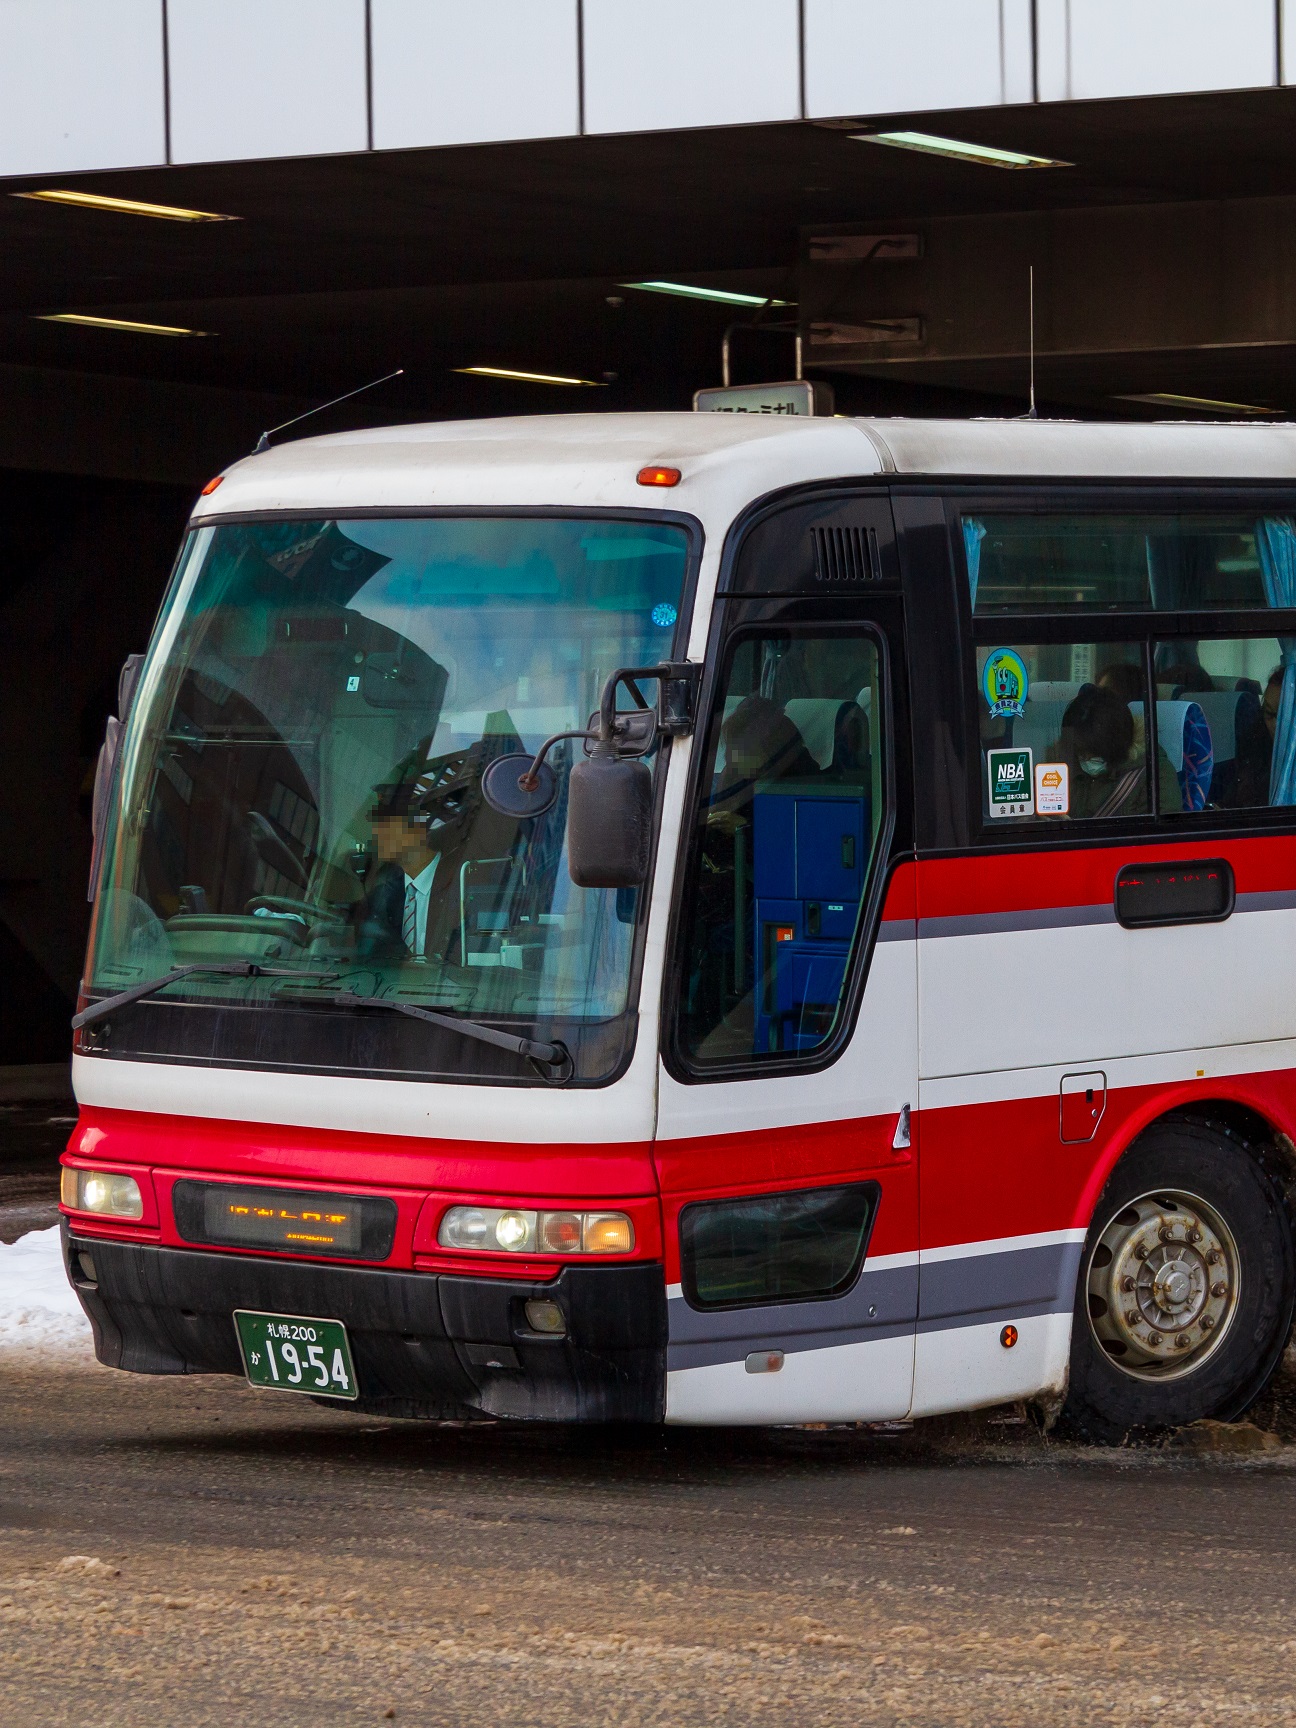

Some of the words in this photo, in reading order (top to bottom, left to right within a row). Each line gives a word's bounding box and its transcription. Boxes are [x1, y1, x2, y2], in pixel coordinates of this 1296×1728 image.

[998, 763, 1025, 779] NBA
[250, 1351, 261, 1366] か
[265, 1340, 349, 1390] 19-54
